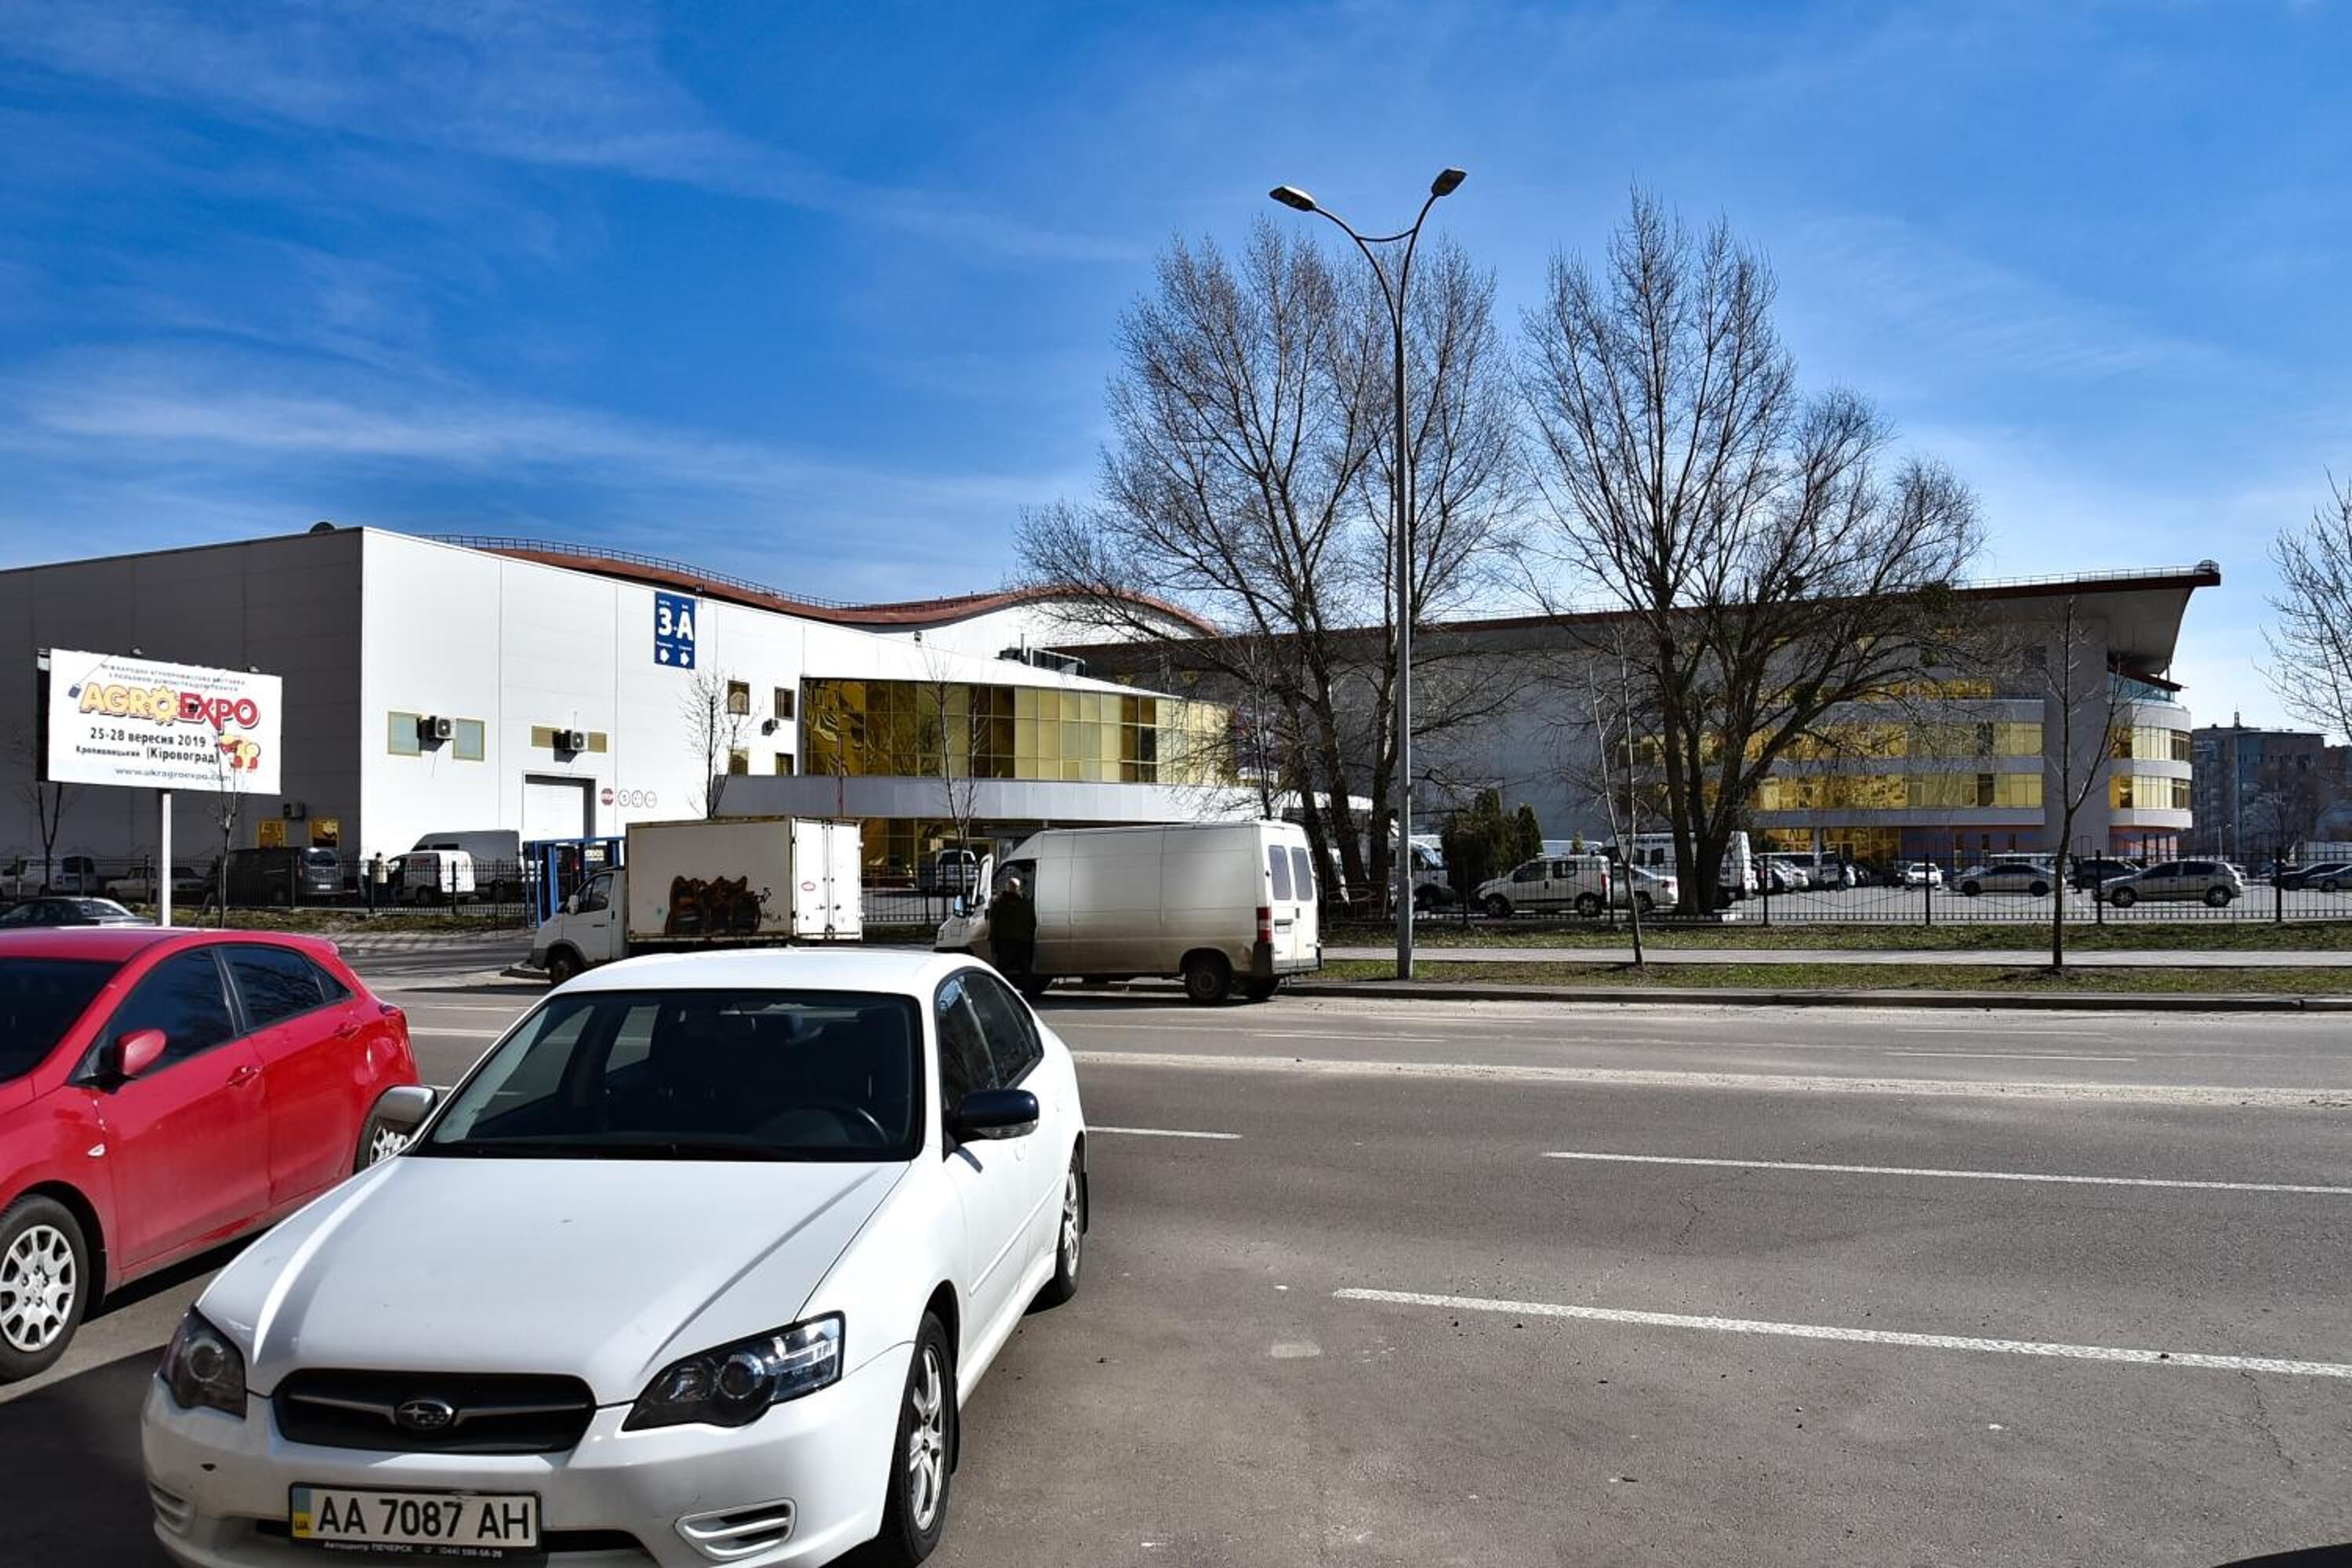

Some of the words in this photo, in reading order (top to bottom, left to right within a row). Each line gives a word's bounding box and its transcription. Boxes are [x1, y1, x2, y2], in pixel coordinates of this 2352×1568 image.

[90, 728, 125, 741] 25-28
[129, 732, 174, 746] вересня
[178, 735, 206, 747] 2019
[318, 1497, 367, 1534] AA
[379, 1499, 464, 1537] 7087
[477, 1502, 529, 1540] AH
